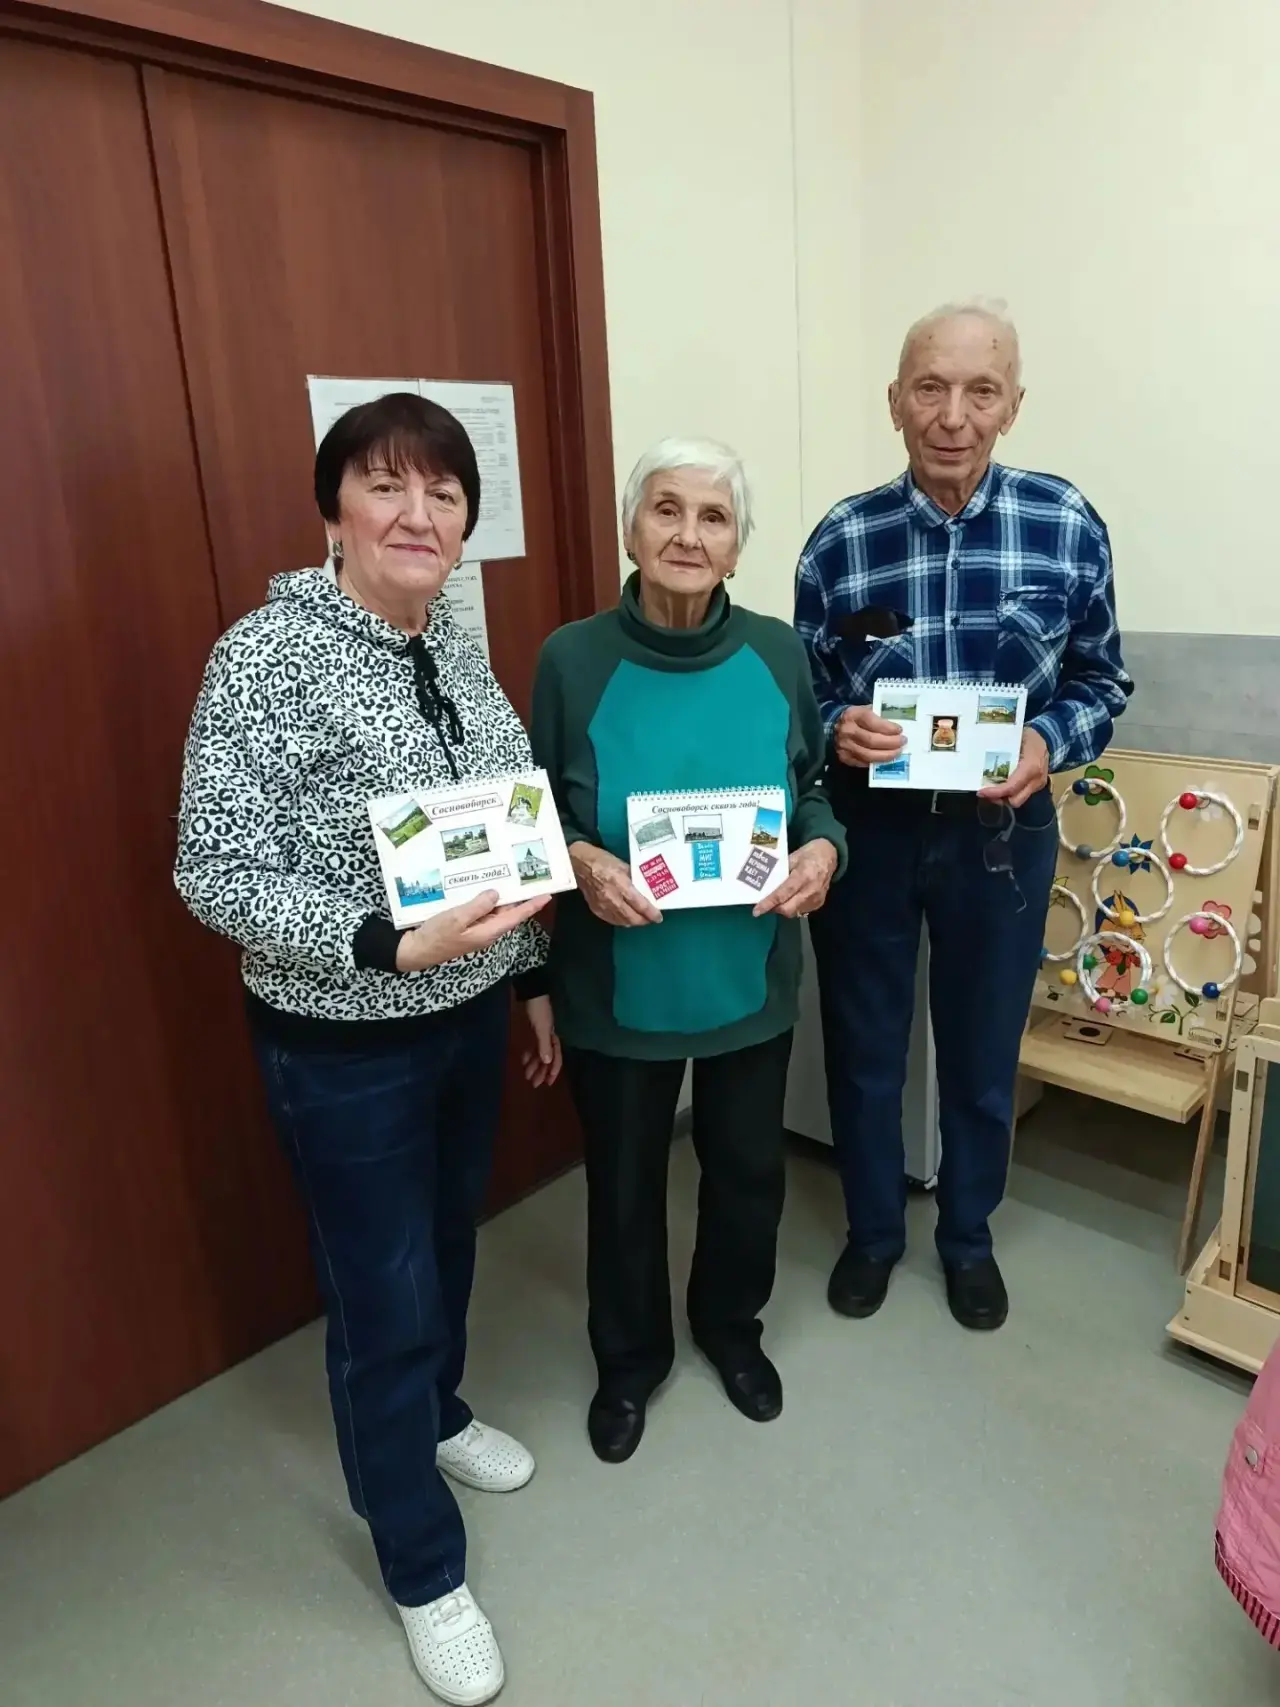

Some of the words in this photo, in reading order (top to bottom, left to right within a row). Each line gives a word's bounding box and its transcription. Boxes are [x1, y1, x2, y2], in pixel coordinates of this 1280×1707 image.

[432, 797, 497, 816] Сосновоборск
[652, 804, 709, 814] Сосновоборск
[738, 800, 761, 808] года!
[481, 867, 506, 879] года!
